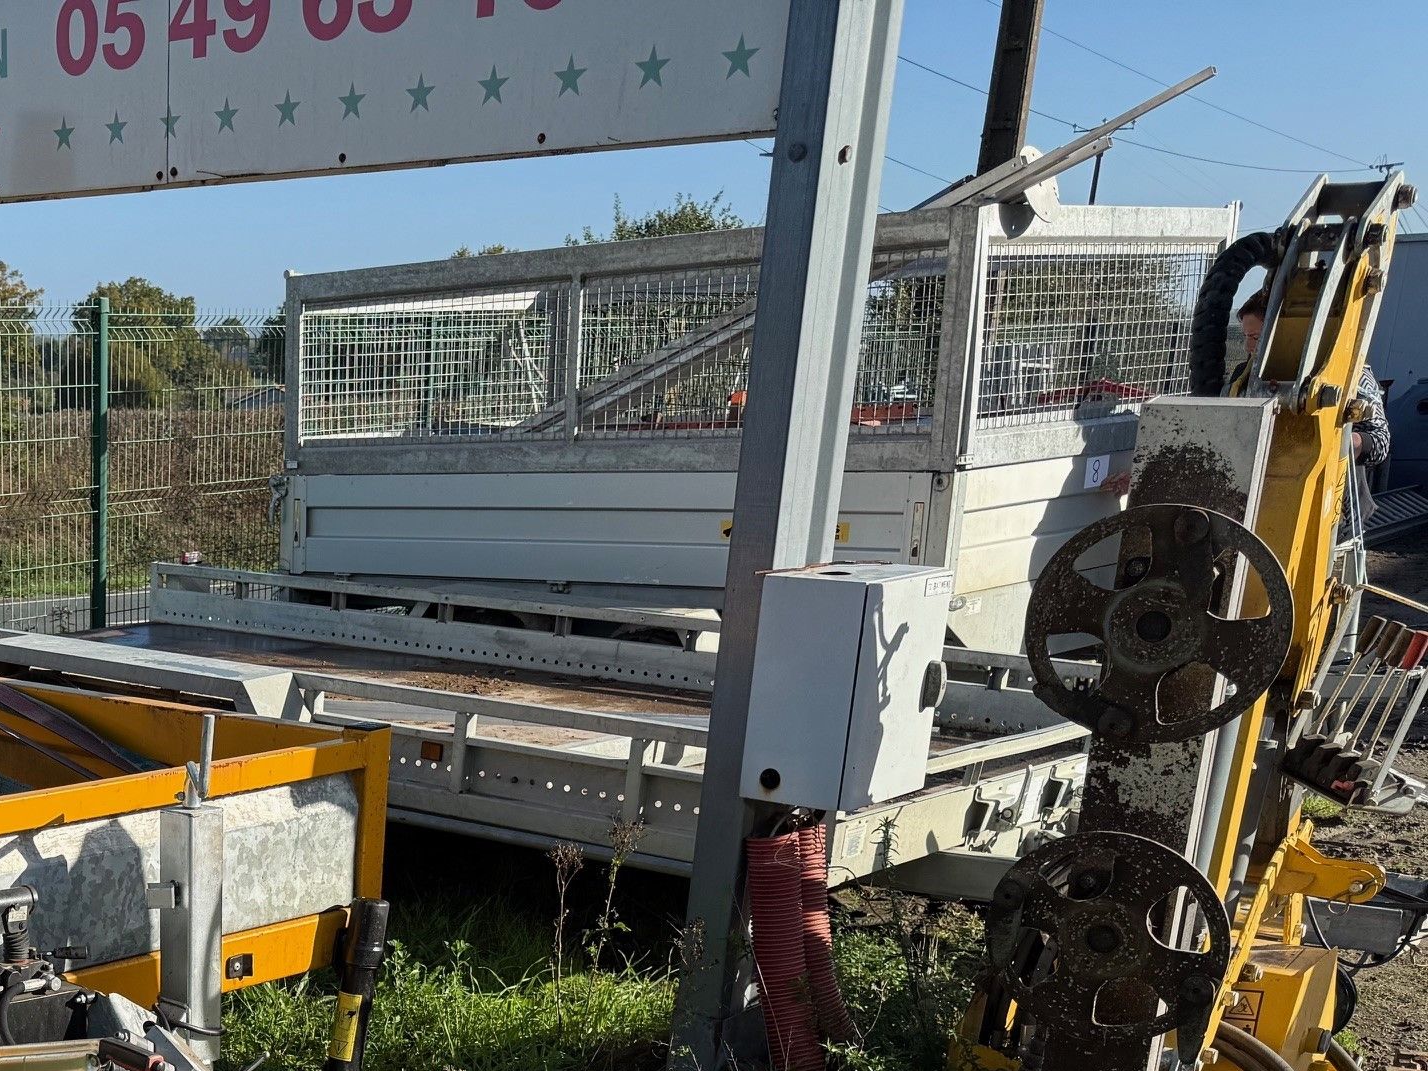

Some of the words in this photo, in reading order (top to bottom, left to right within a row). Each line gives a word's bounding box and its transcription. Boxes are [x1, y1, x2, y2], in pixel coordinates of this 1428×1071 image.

[56, 0, 145, 76] 05
[169, 0, 271, 58] 49
[1092, 459, 1101, 483] 8
